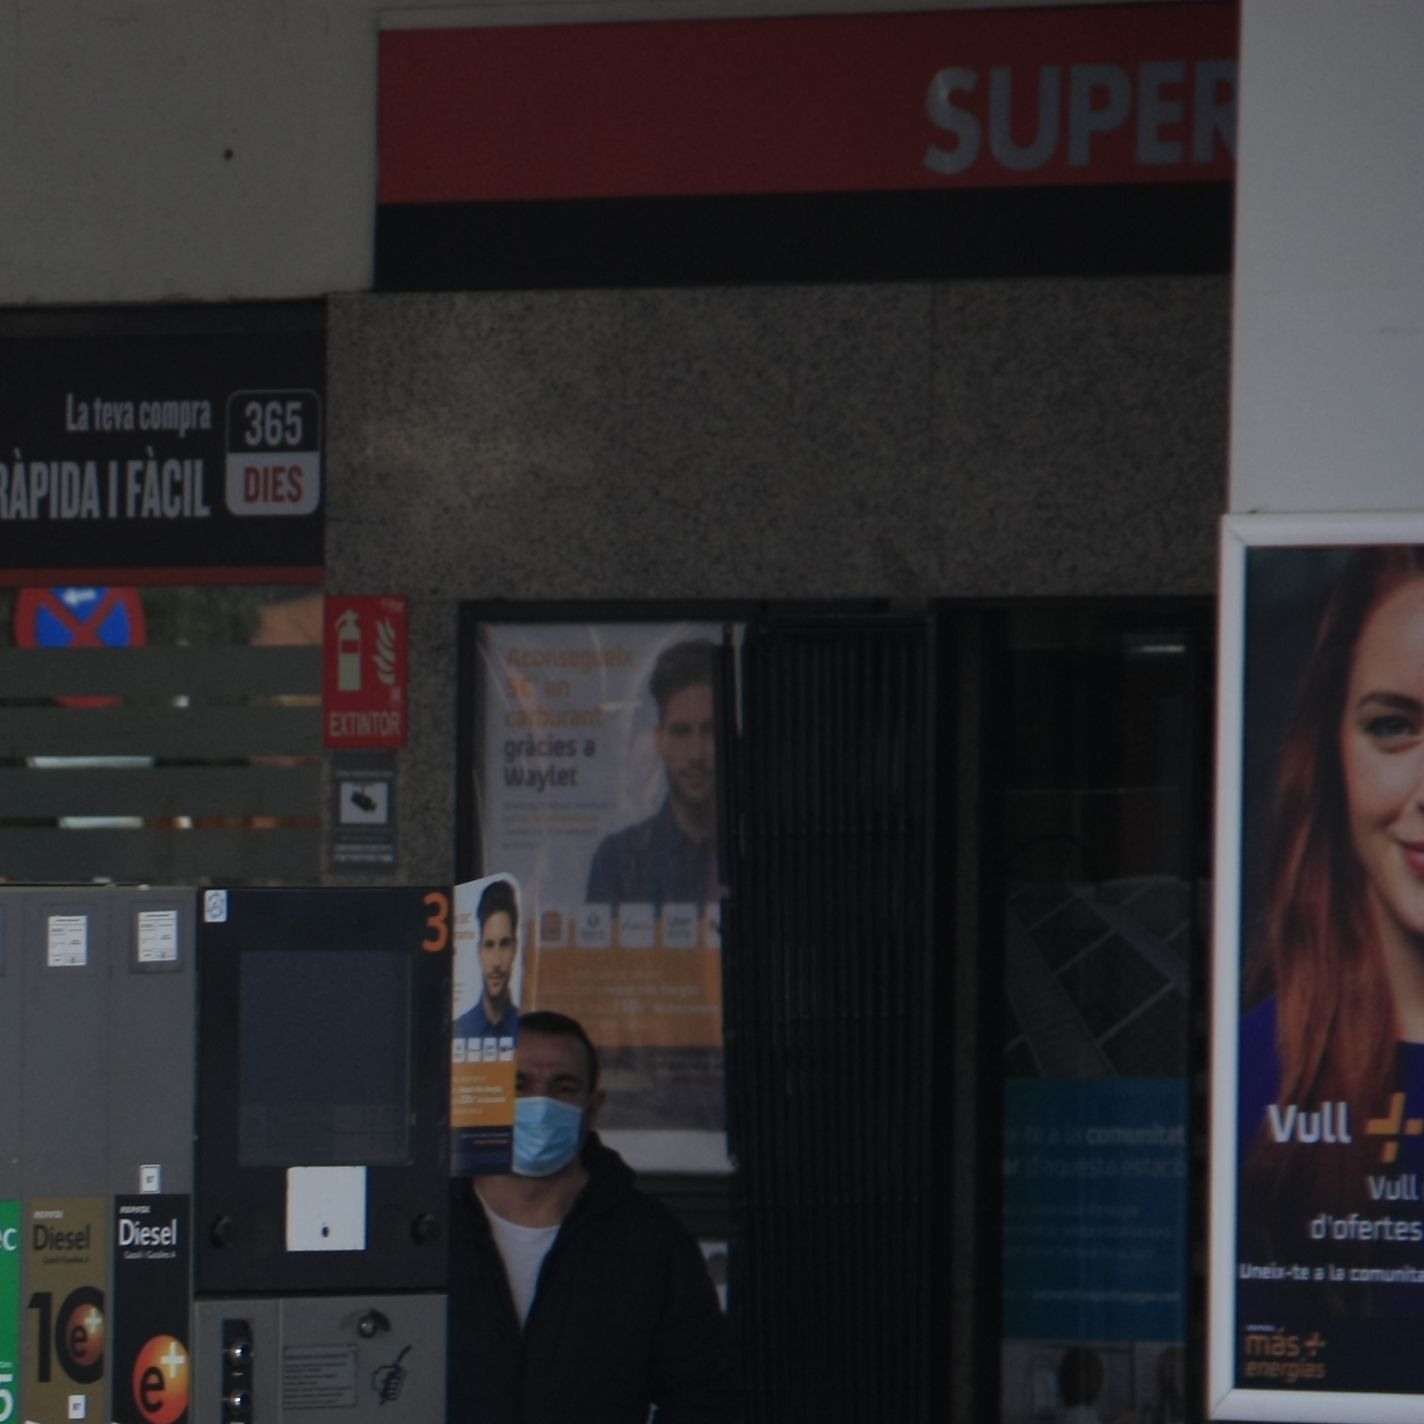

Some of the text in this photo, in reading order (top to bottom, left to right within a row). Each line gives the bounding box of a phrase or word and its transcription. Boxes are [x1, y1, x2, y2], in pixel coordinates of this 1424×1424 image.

[922, 60, 1237, 177] SUPER
[65, 393, 212, 438] La teva compra
[244, 401, 303, 446] 365
[107, 460, 118, 518] I
[126, 445, 212, 518] FÀCIL
[243, 466, 305, 503] DIES
[329, 711, 401, 737] EXTINTOR
[504, 734, 597, 764] gràcies a
[504, 764, 579, 793] Waylet
[421, 890, 449, 952] 3
[1267, 1101, 1352, 1145] Vull
[1367, 1173, 1419, 1201] Vull
[33, 1224, 90, 1251] Diesel
[118, 1217, 178, 1247] Diesel
[1308, 1213, 1422, 1242] d'ofertes
[1238, 1262, 1309, 1281] Uneix-te
[1313, 1267, 1324, 1280] a
[1328, 1263, 1345, 1282] la
[1244, 1326, 1301, 1357] más
[1244, 1358, 1326, 1384] energías
